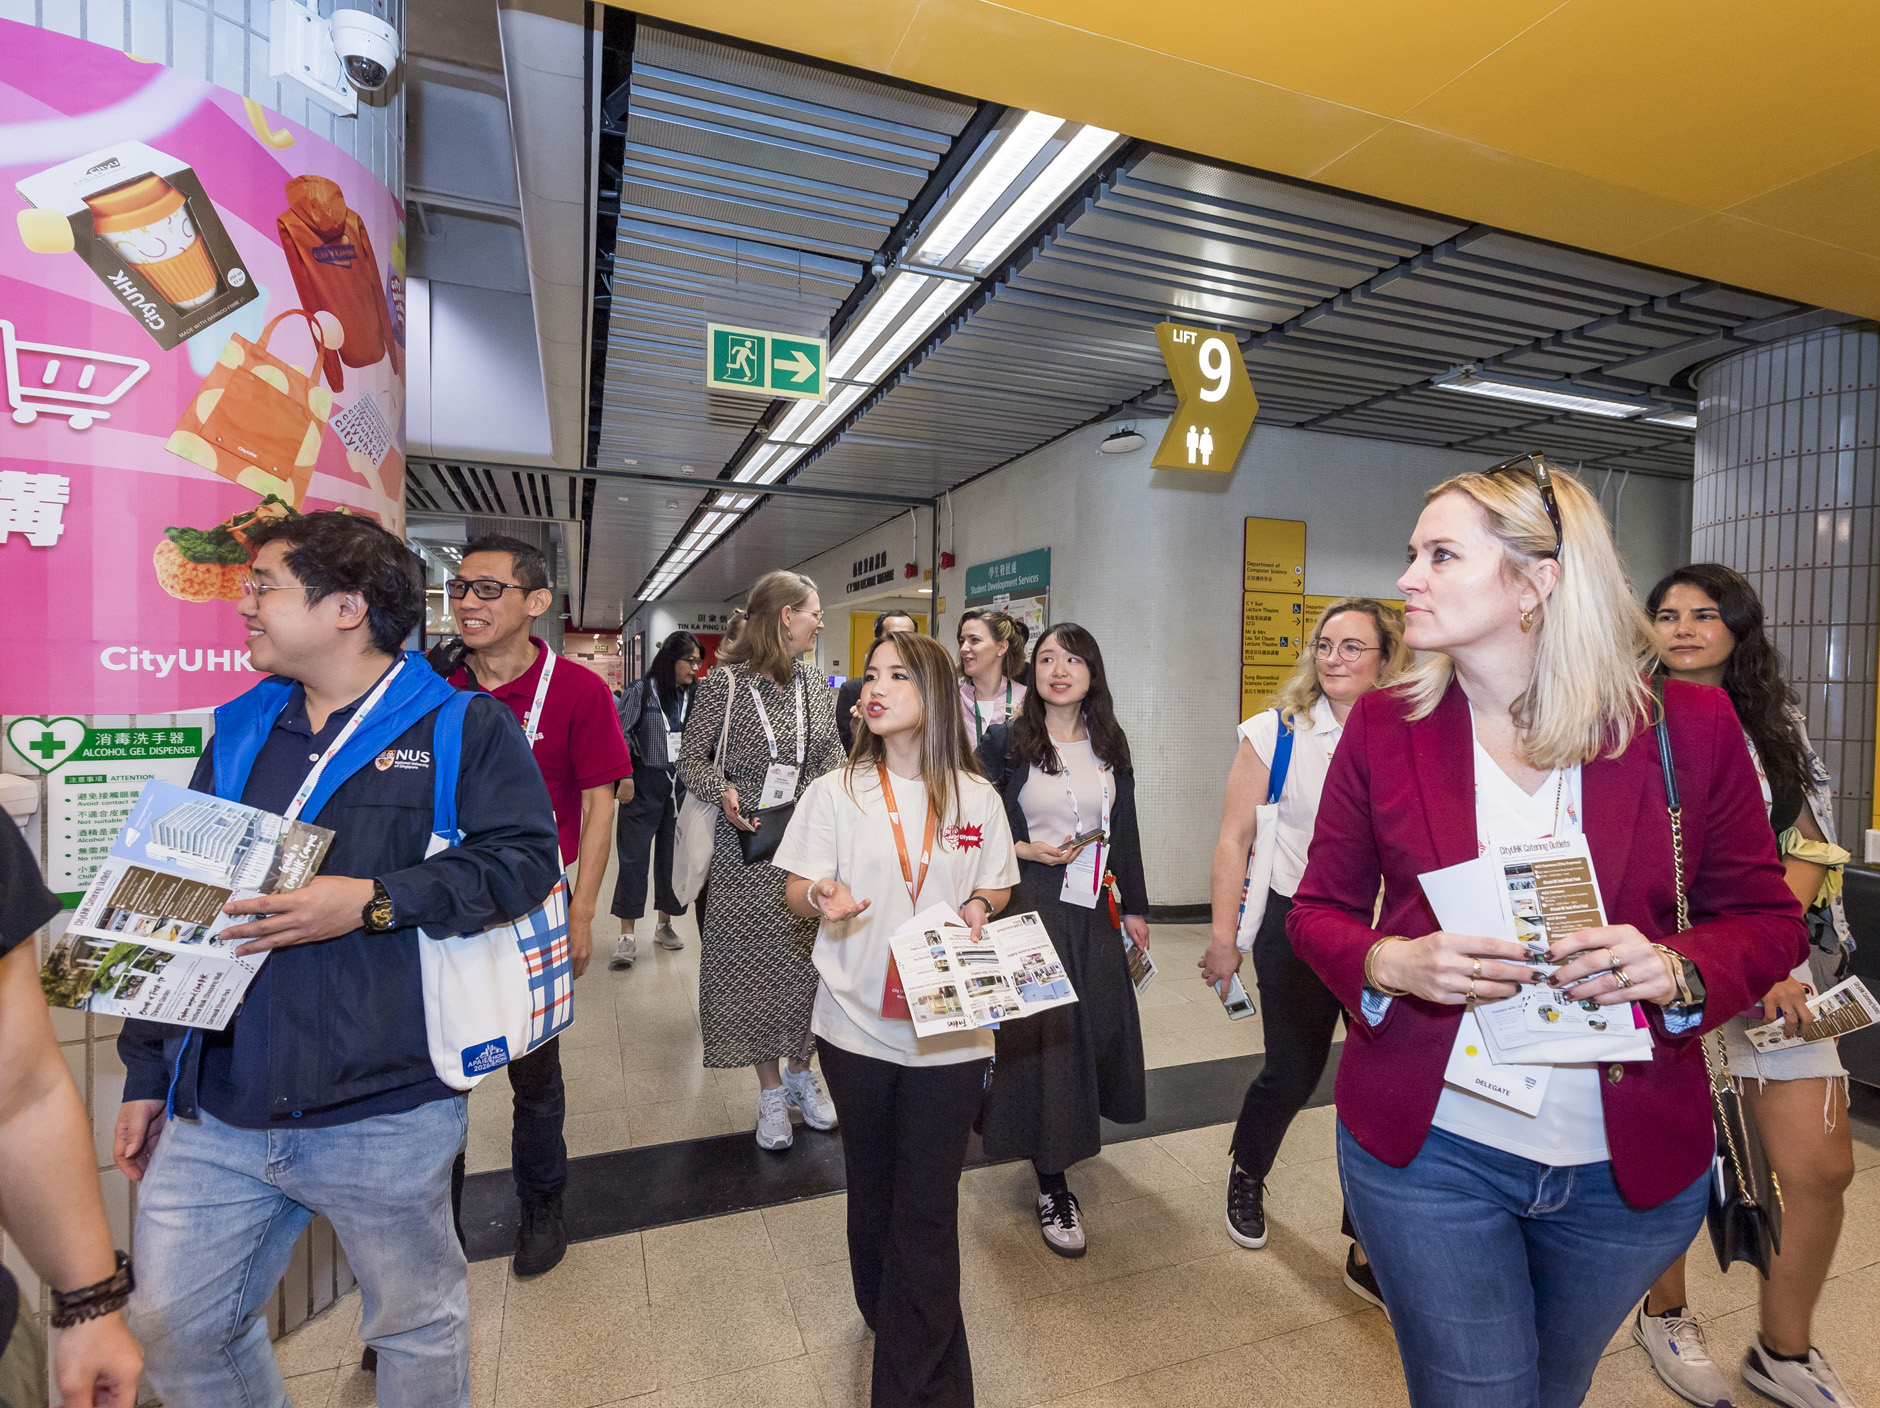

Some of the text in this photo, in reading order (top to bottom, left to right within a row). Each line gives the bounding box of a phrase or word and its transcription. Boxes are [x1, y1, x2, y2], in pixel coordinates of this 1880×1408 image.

[107, 269, 165, 331] CityUHK
[178, 327, 194, 338] MADE
[193, 317, 208, 331] WITH
[206, 306, 228, 326] BAMBOO
[1173, 328, 1197, 345] LIFT
[1198, 337, 1231, 402] 9
[970, 574, 1039, 595] Student Development Services
[100, 646, 256, 677] CityUHK
[95, 732, 185, 746] 消毒洗手器
[82, 745, 196, 757] ALCOHOL GEL DISPENSER
[396, 749, 430, 763] NUS
[78, 809, 132, 818] 不適合皮膚
[77, 828, 122, 836] 酒精是高
[1500, 840, 1572, 856] CityUHK Catering Outlets
[1475, 1078, 1511, 1097] DELEGATE
